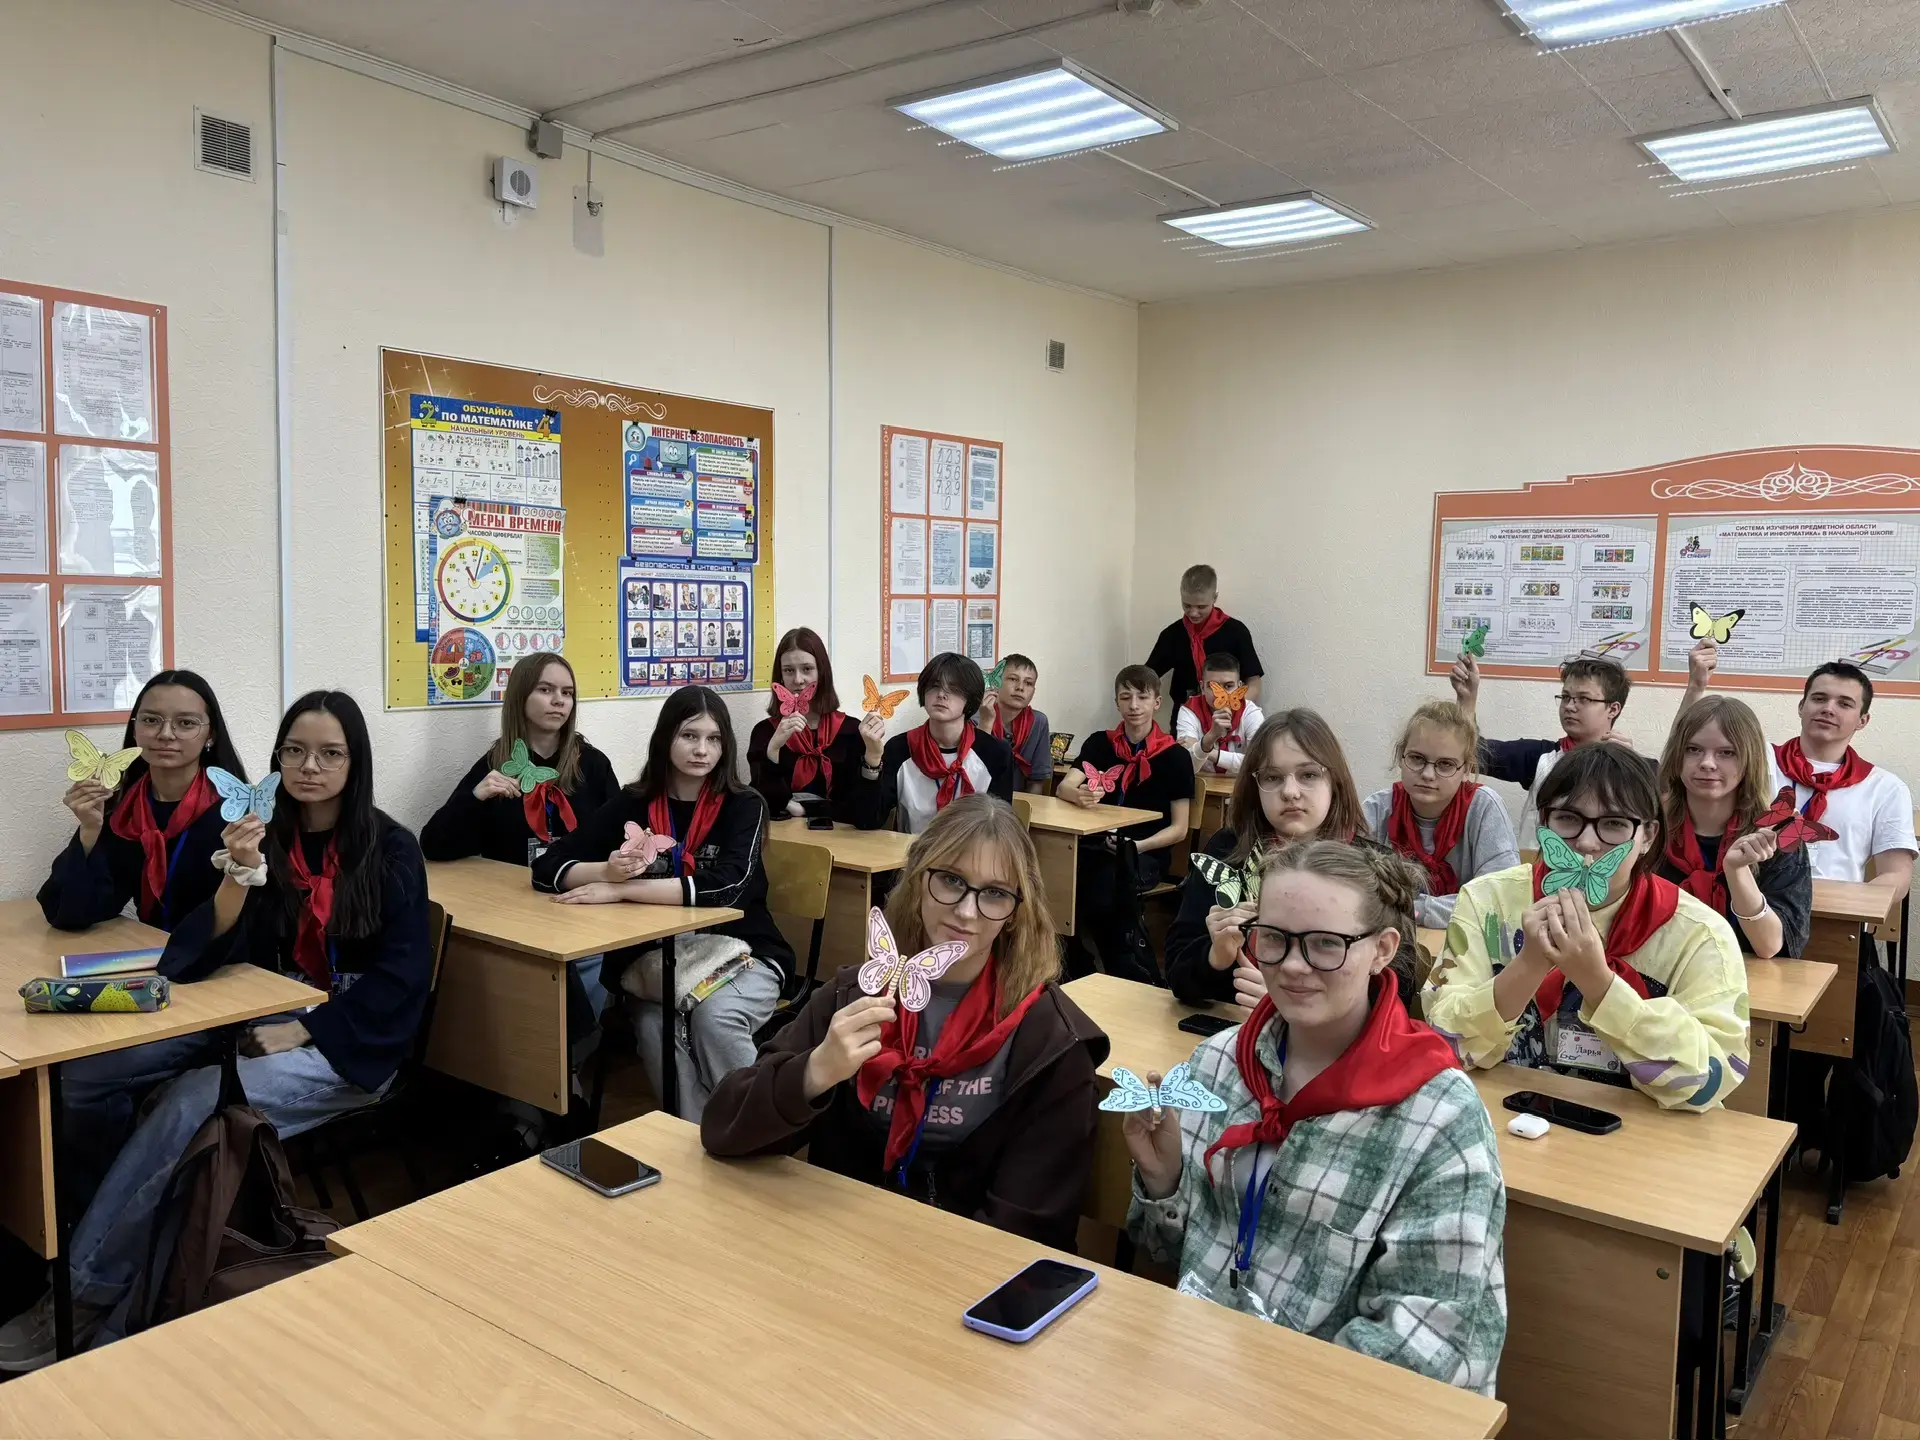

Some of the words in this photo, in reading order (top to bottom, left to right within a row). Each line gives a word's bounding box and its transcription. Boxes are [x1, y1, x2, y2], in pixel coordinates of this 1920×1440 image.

[463, 404, 514, 417] ОБУЧАЙКА
[441, 412, 458, 422] ПО
[461, 415, 534, 430] МАТЕМАТИКЕ
[450, 425, 494, 435] НАЧАЛЬНЫЙ
[495, 430, 525, 439] УРОВЕНЬ
[652, 426, 744, 448] ИНТЕРНЕТ-БЕЗОПАСНОСТЬ
[946, 449, 953, 463] 2
[954, 450, 961, 464] 3
[945, 464, 952, 479] 5
[954, 465, 961, 480] 6
[945, 480, 952, 495] 8
[954, 481, 961, 496] 9
[945, 496, 951, 510] 0
[467, 510, 505, 528] МЕРЫ
[509, 516, 562, 533] ВРЕМЕНИ
[493, 531, 523, 539] ЦИФЕРБЛАТ
[1576, 1044, 1602, 1056] Дарья
[957, 1077, 992, 1095] THE
